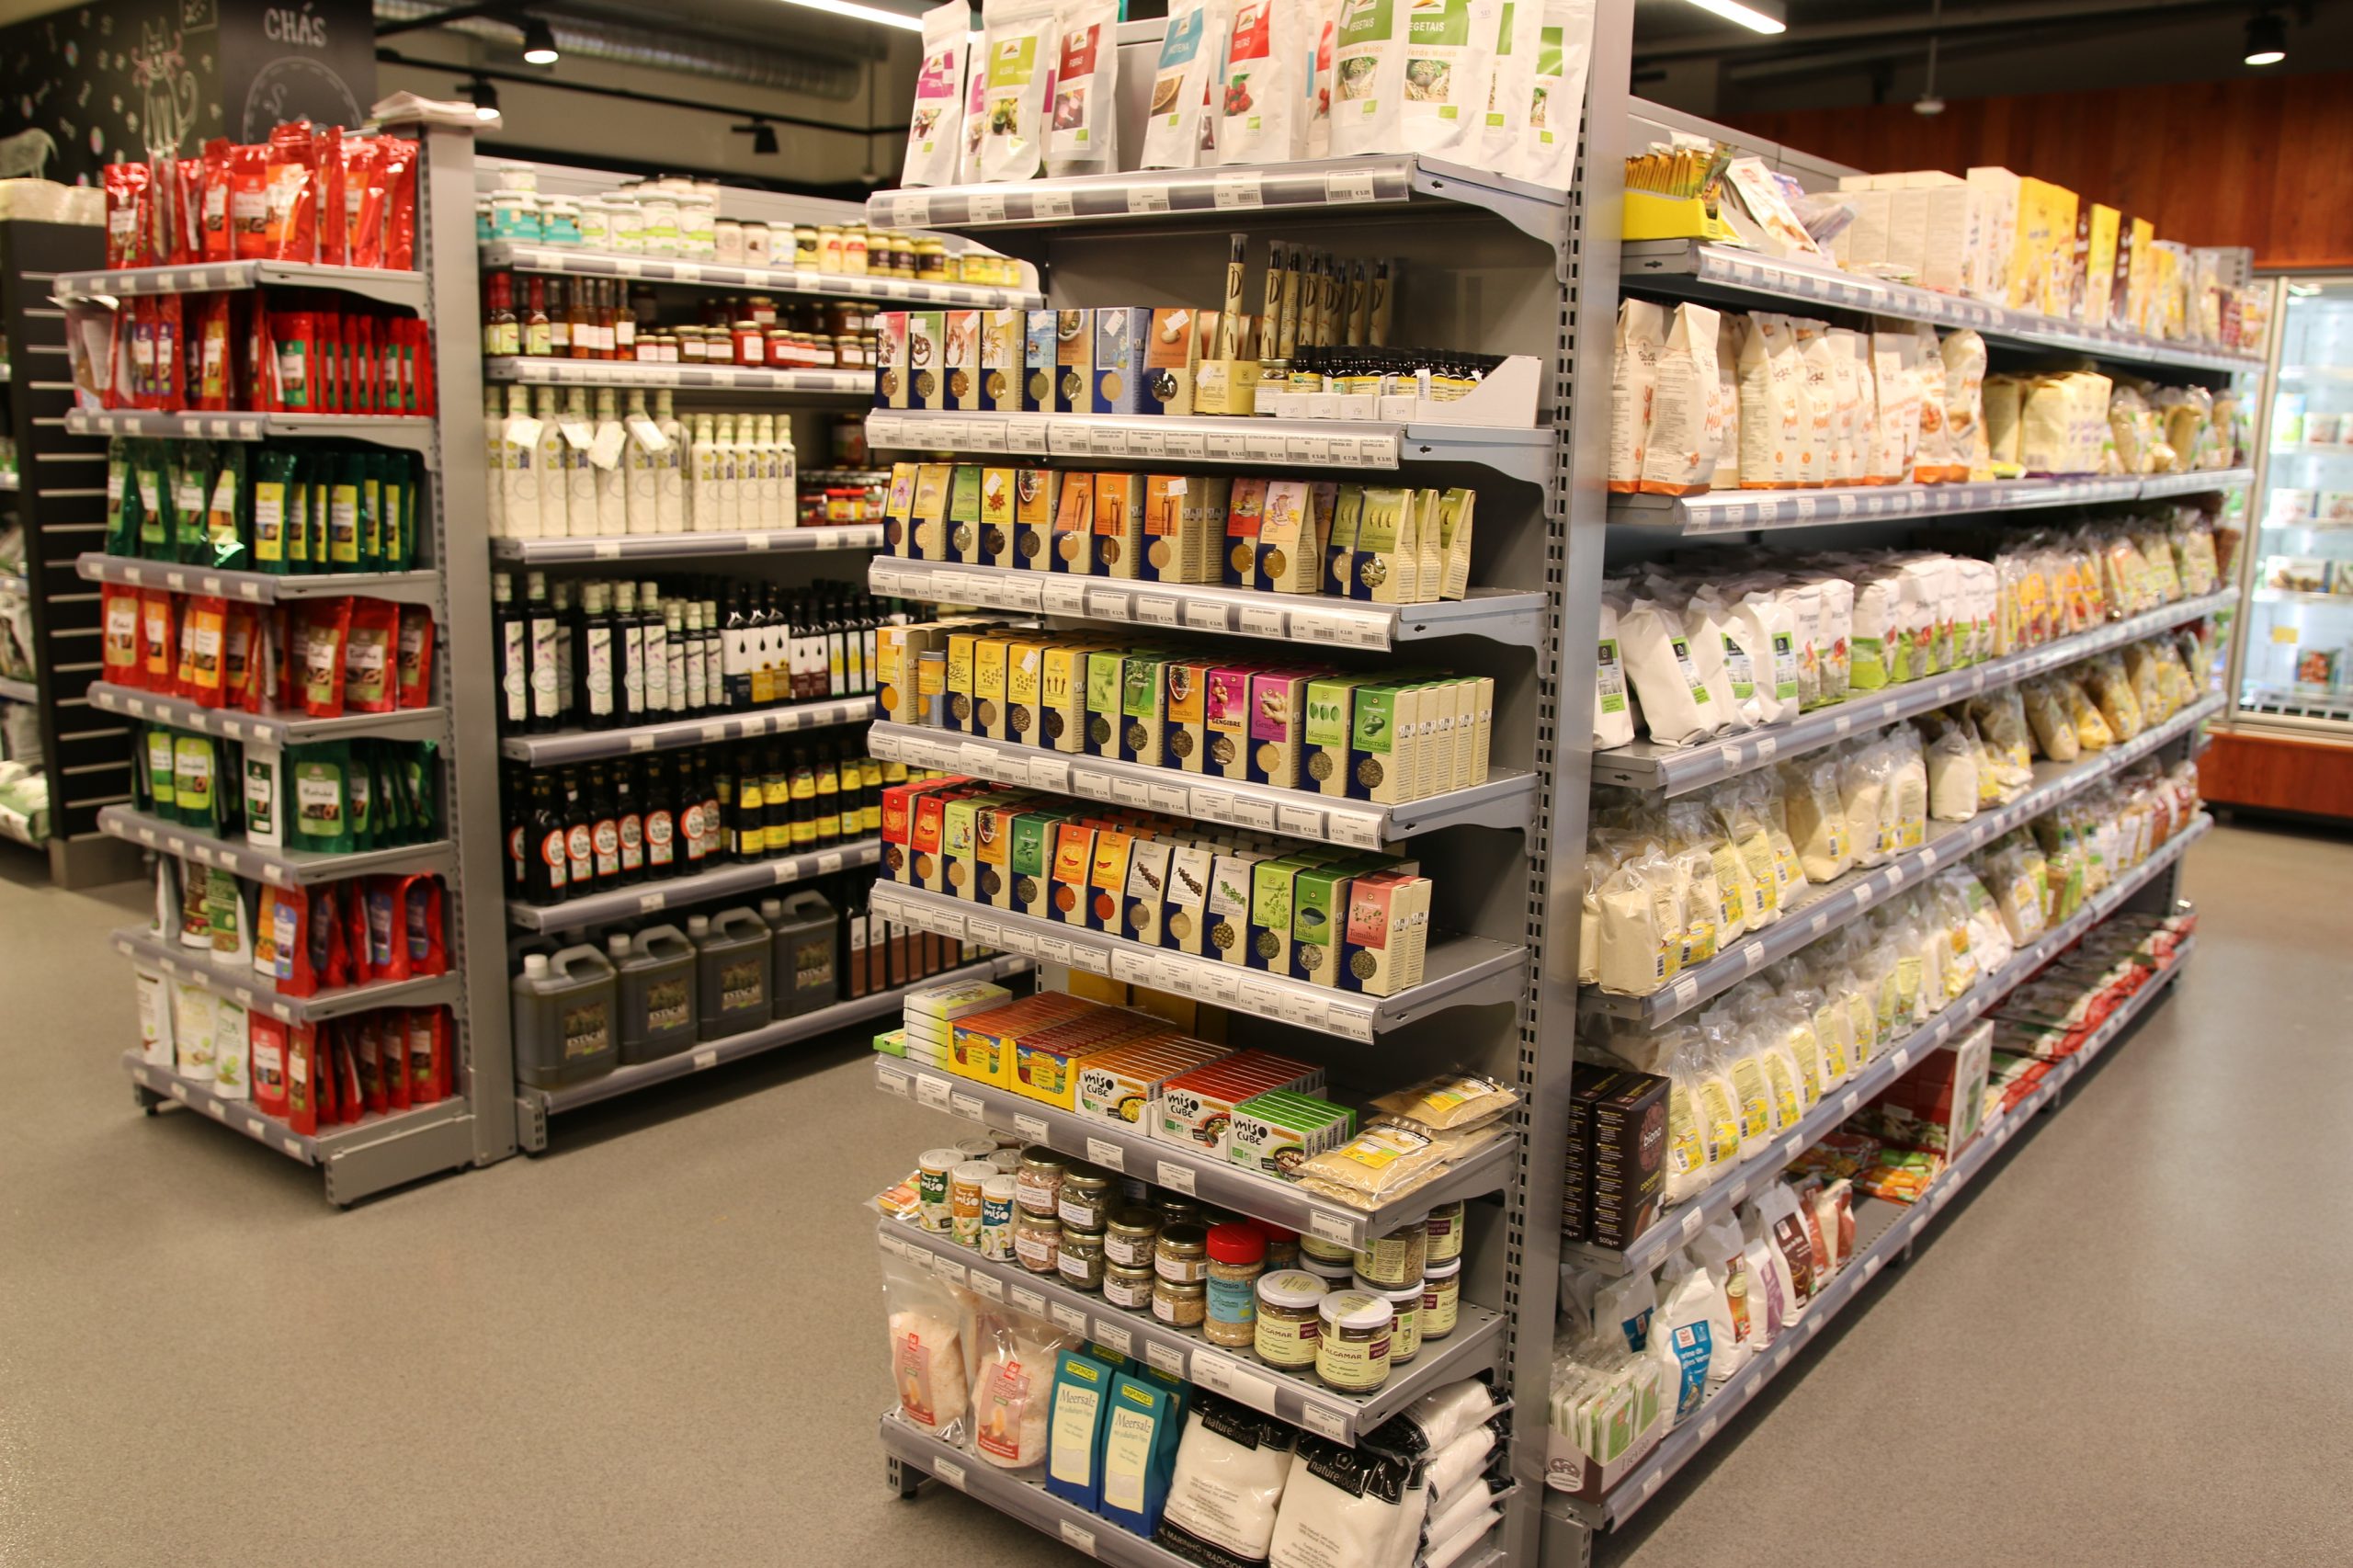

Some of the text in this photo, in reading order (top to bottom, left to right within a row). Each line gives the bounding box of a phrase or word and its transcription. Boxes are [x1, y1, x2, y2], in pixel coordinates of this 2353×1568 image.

[264, 3, 327, 49] CHÁS
[1408, 21, 1445, 32] EGETAIS
[1170, 707, 1192, 717] Funcho
[1211, 718, 1242, 728] GENGIBRE
[1355, 734, 1391, 749] Manjericão
[1295, 918, 1313, 930] Salva
[1295, 929, 1314, 939] folhas
[1349, 927, 1379, 941] Tomilho
[1083, 1072, 1114, 1091] miso
[1086, 1084, 1109, 1097] CUBE
[1166, 1093, 1199, 1111] miso
[1170, 1105, 1194, 1119] CUBE
[1233, 1119, 1267, 1139] miso
[1236, 1131, 1262, 1146] CUBE
[1643, 1126, 1663, 1148] biona
[921, 1180, 944, 1192] miso
[955, 1195, 980, 1207] miso
[983, 1209, 1009, 1221] miso
[1259, 1324, 1293, 1339] ALGAMAR
[1324, 1346, 1363, 1361] ALGAMAR
[1059, 1389, 1097, 1408] Meersalz
[1115, 1413, 1152, 1434] Meersalz
[1166, 1530, 1202, 1552] MARINHO
